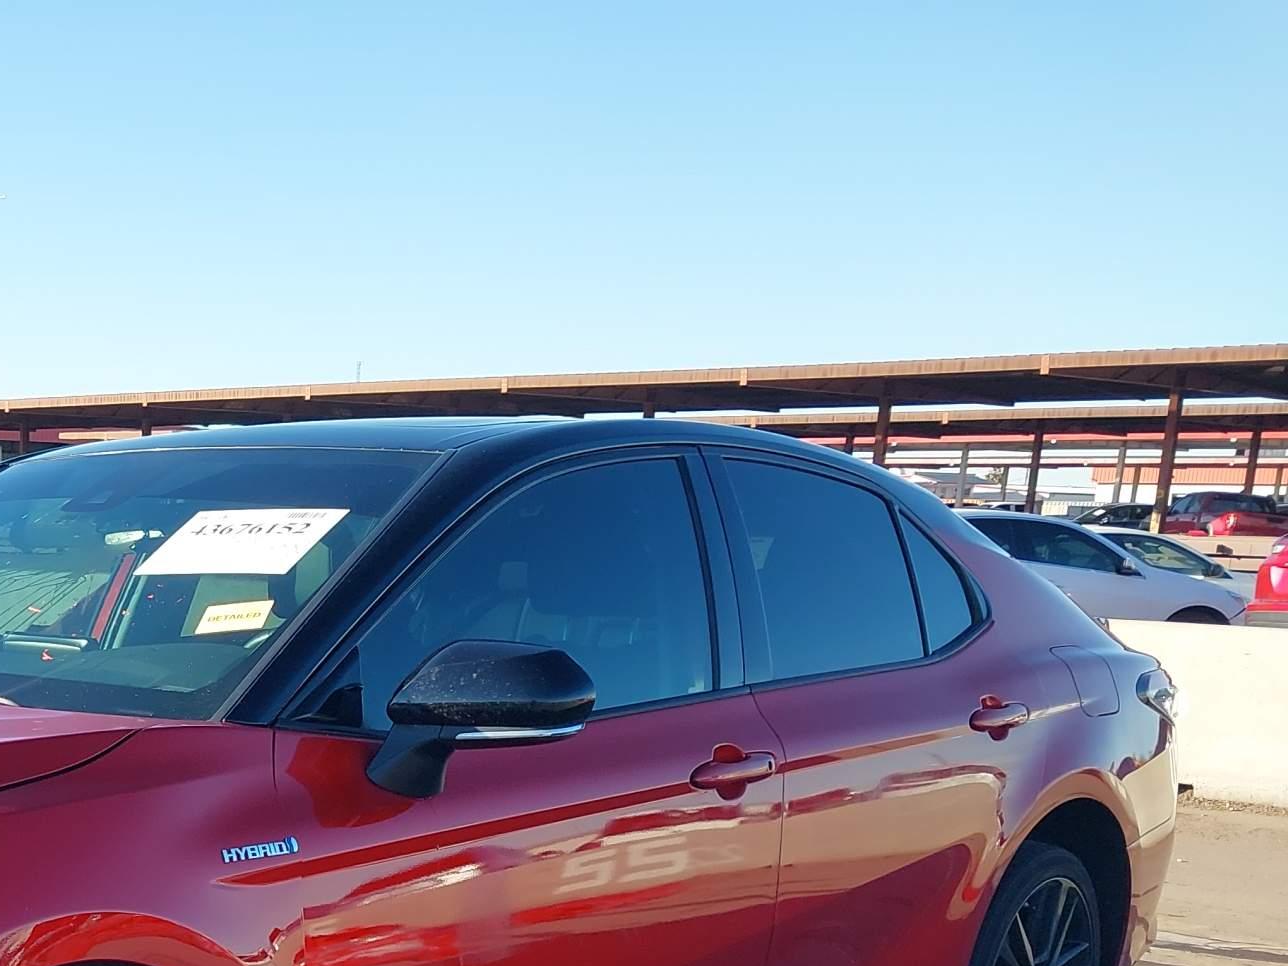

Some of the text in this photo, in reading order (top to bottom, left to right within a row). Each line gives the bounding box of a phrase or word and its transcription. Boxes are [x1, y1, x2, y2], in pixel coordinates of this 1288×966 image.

[191, 522, 311, 537] 43676152
[208, 612, 262, 622] DETAILED
[221, 841, 290, 864] HYBRID
